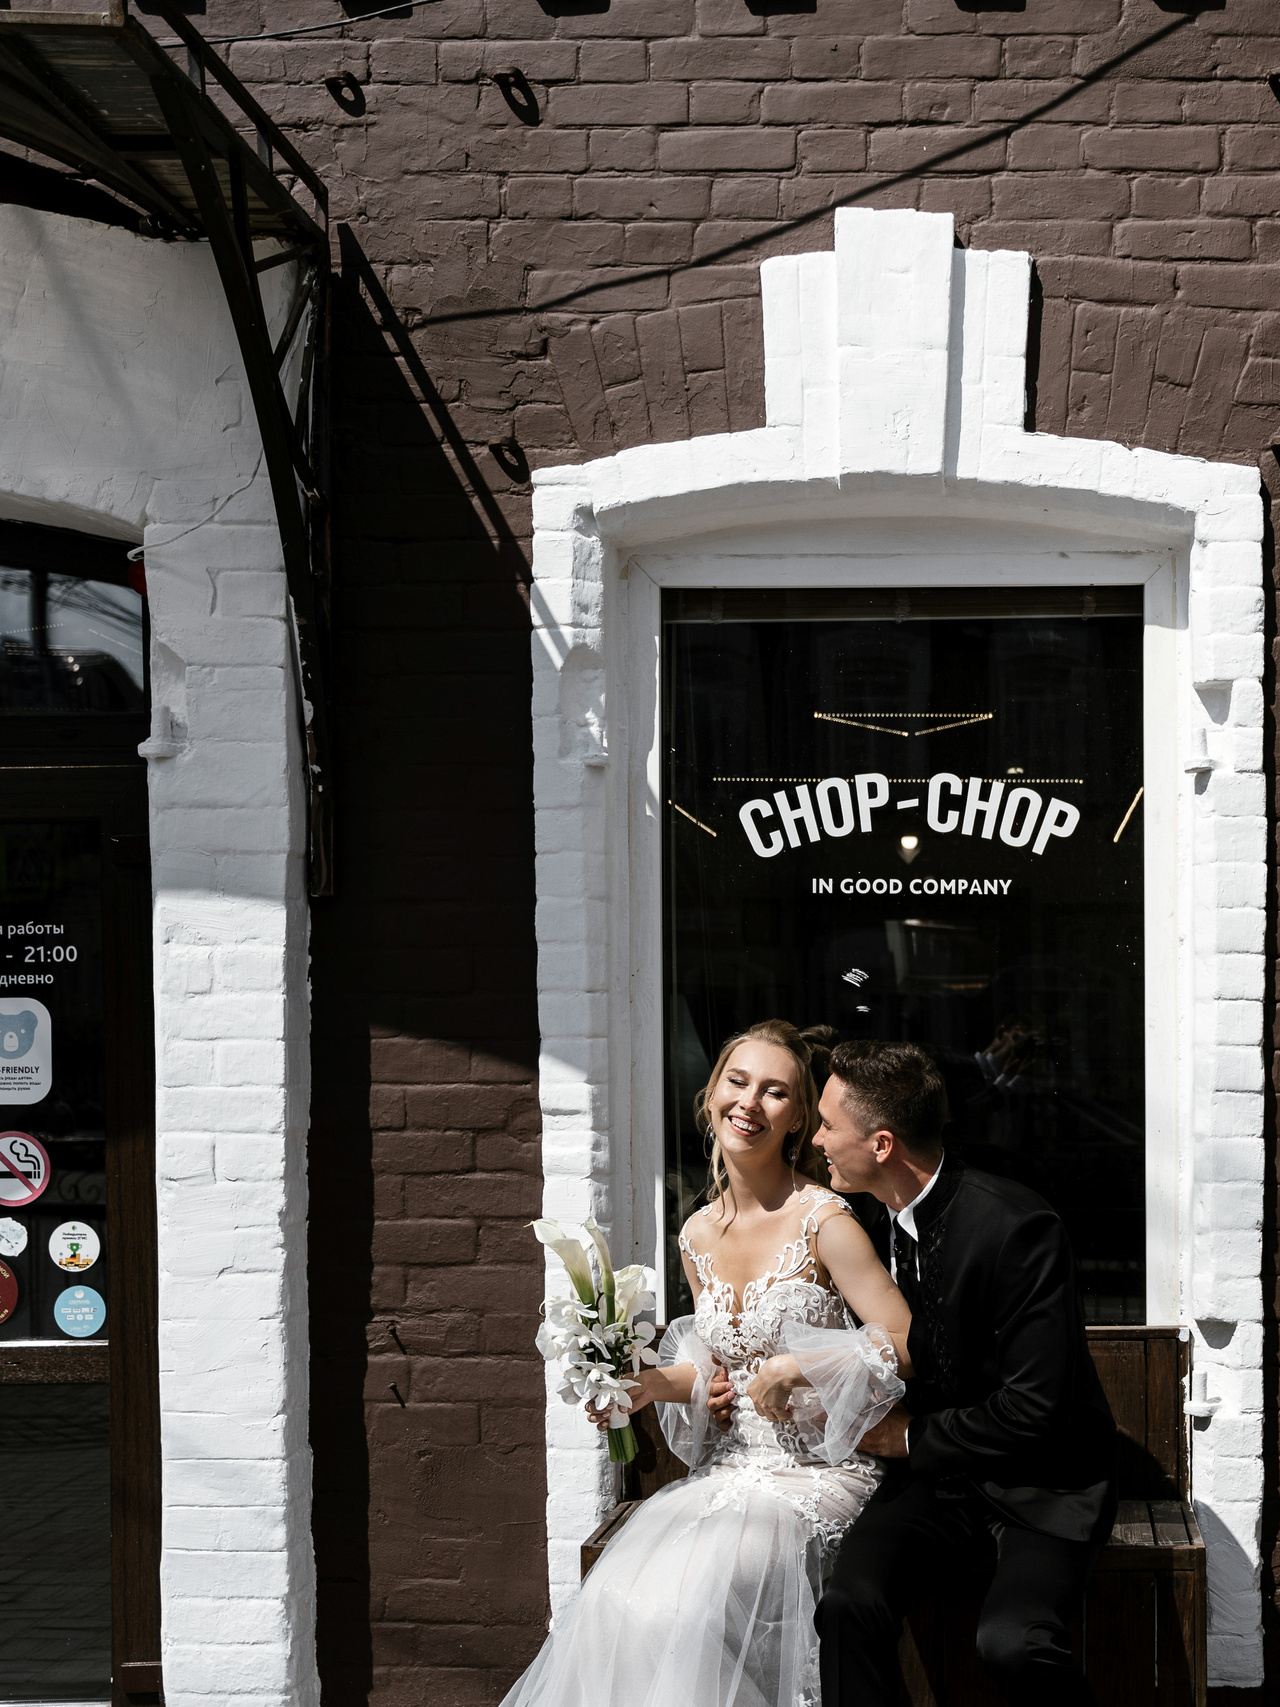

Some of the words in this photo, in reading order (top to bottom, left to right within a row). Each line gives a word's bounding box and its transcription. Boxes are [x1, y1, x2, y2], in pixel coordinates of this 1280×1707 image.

[738, 772, 1081, 858] CHOP-CHOP
[812, 877, 834, 894] IN
[839, 878, 903, 895] GOOD
[909, 878, 1013, 895] COMPANY
[8, 921, 64, 939] работы
[25, 945, 78, 963] 21:00
